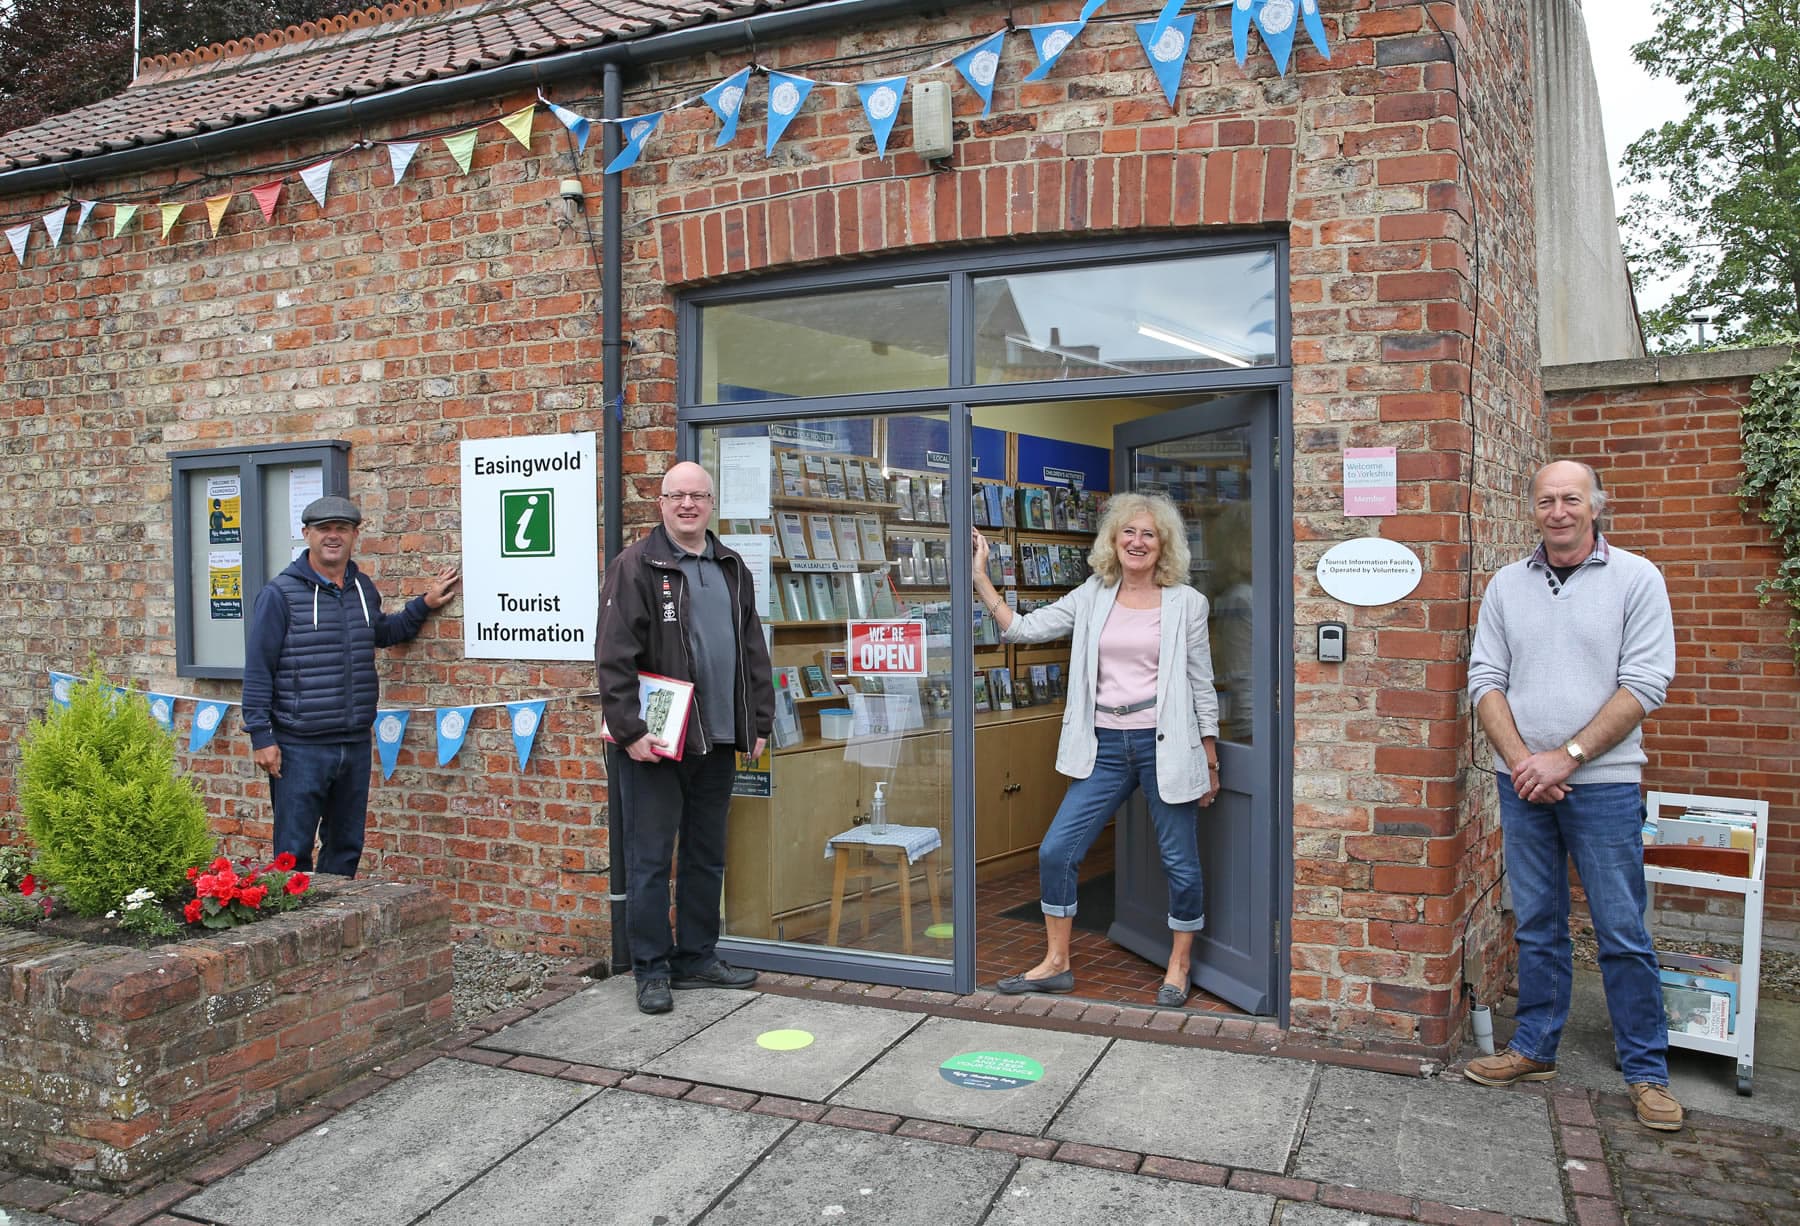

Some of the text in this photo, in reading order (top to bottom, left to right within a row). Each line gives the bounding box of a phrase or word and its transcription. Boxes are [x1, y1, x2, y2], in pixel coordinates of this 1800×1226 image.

[474, 451, 581, 477] Easingwold
[1346, 462, 1383, 470] Welcome
[1356, 470, 1394, 478] Yorkshire
[1349, 558, 1388, 566] Information
[1389, 558, 1414, 566] Facility
[498, 593, 560, 612] Tourist
[477, 622, 585, 643] Information
[869, 626, 905, 642] WE'RE
[860, 644, 915, 670] OPEN
